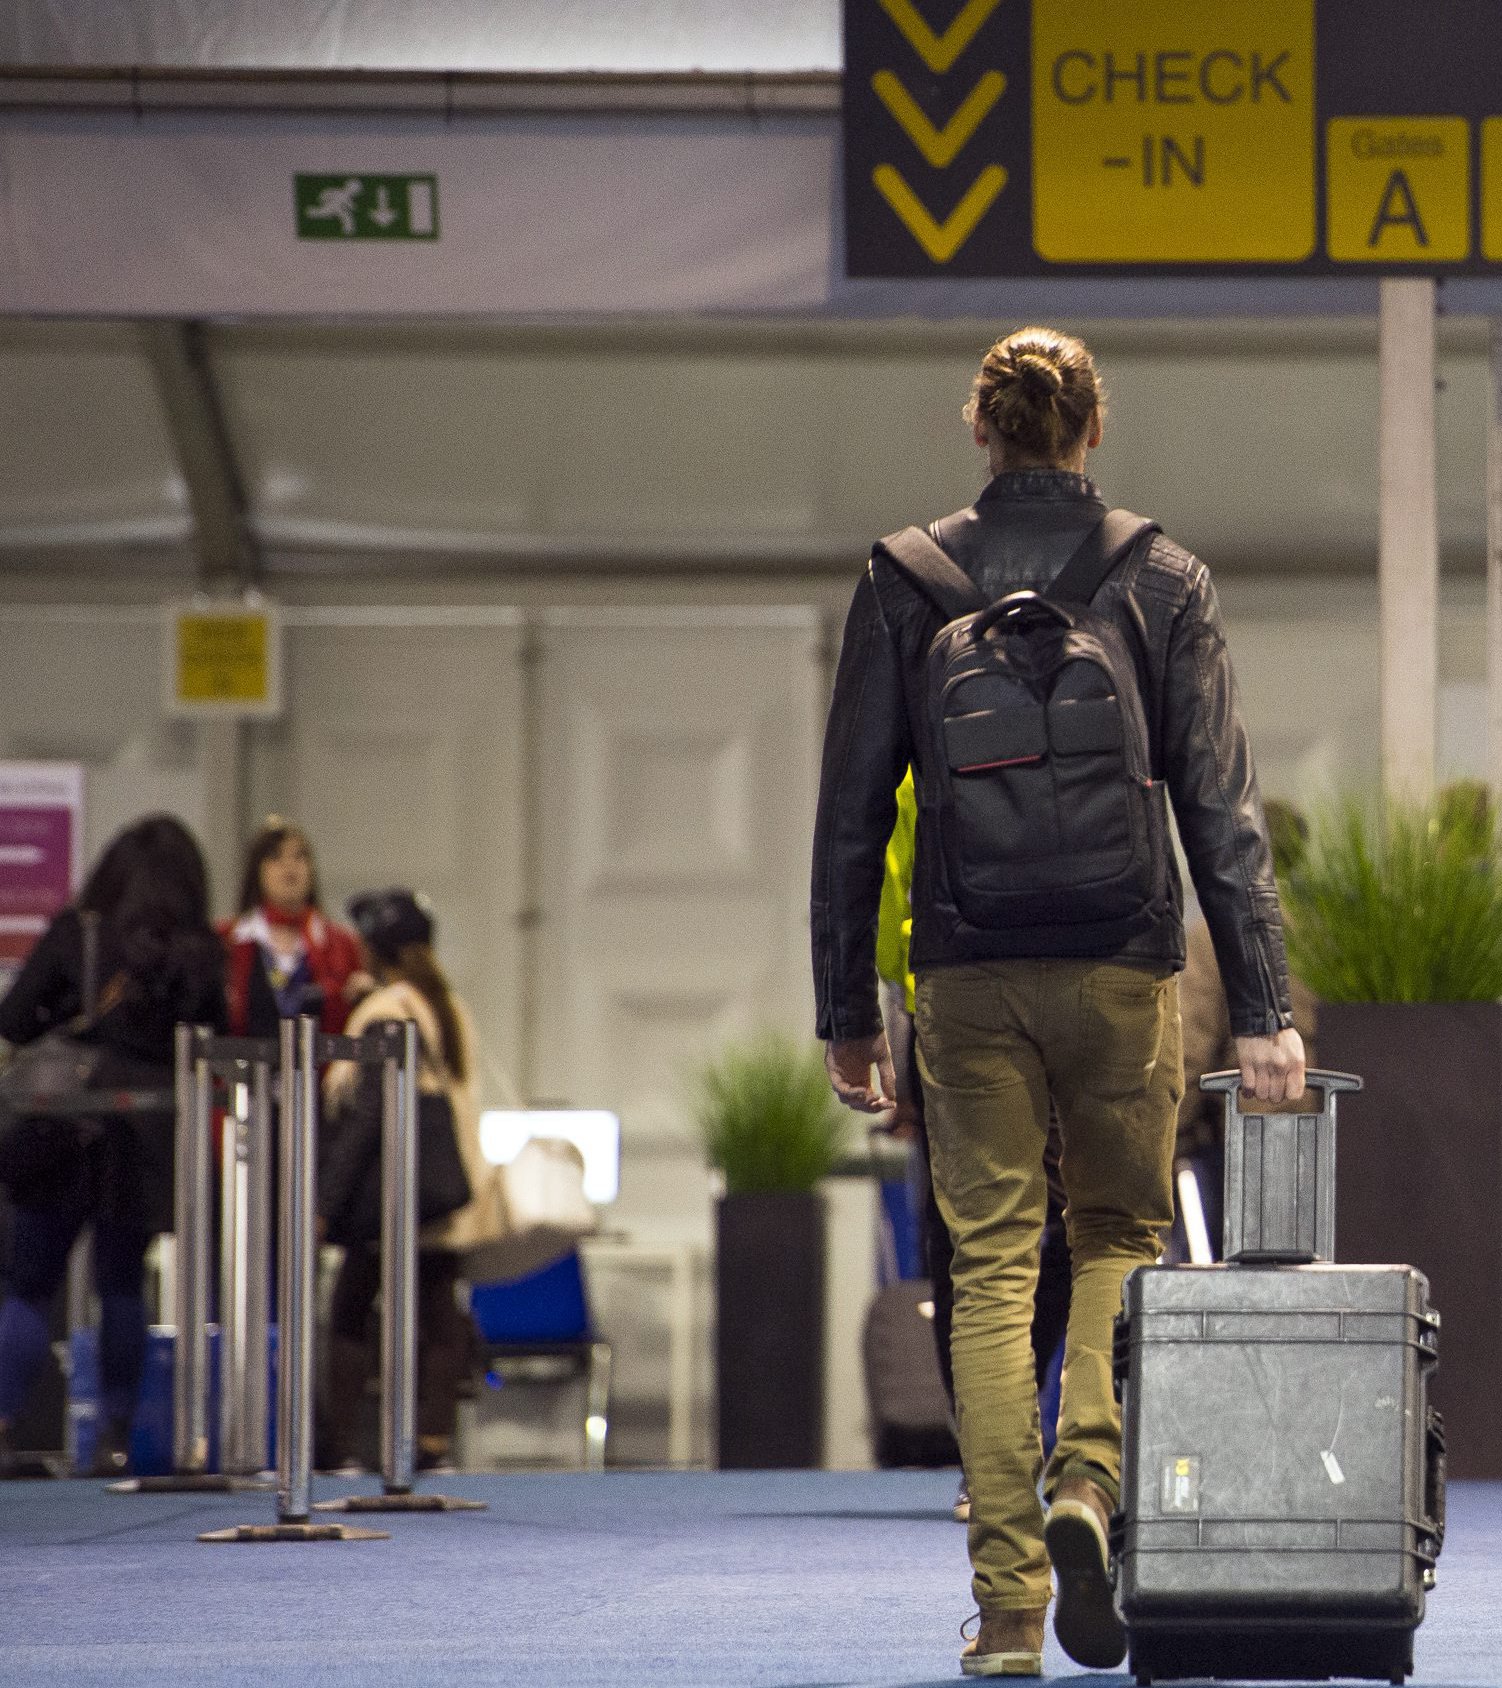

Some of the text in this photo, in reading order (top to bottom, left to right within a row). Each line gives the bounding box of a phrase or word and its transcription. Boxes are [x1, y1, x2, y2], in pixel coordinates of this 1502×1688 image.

[1052, 50, 1293, 105] CHECK
[1102, 134, 1205, 188] -IN
[1350, 127, 1445, 159] Gates
[1367, 168, 1430, 248] A
